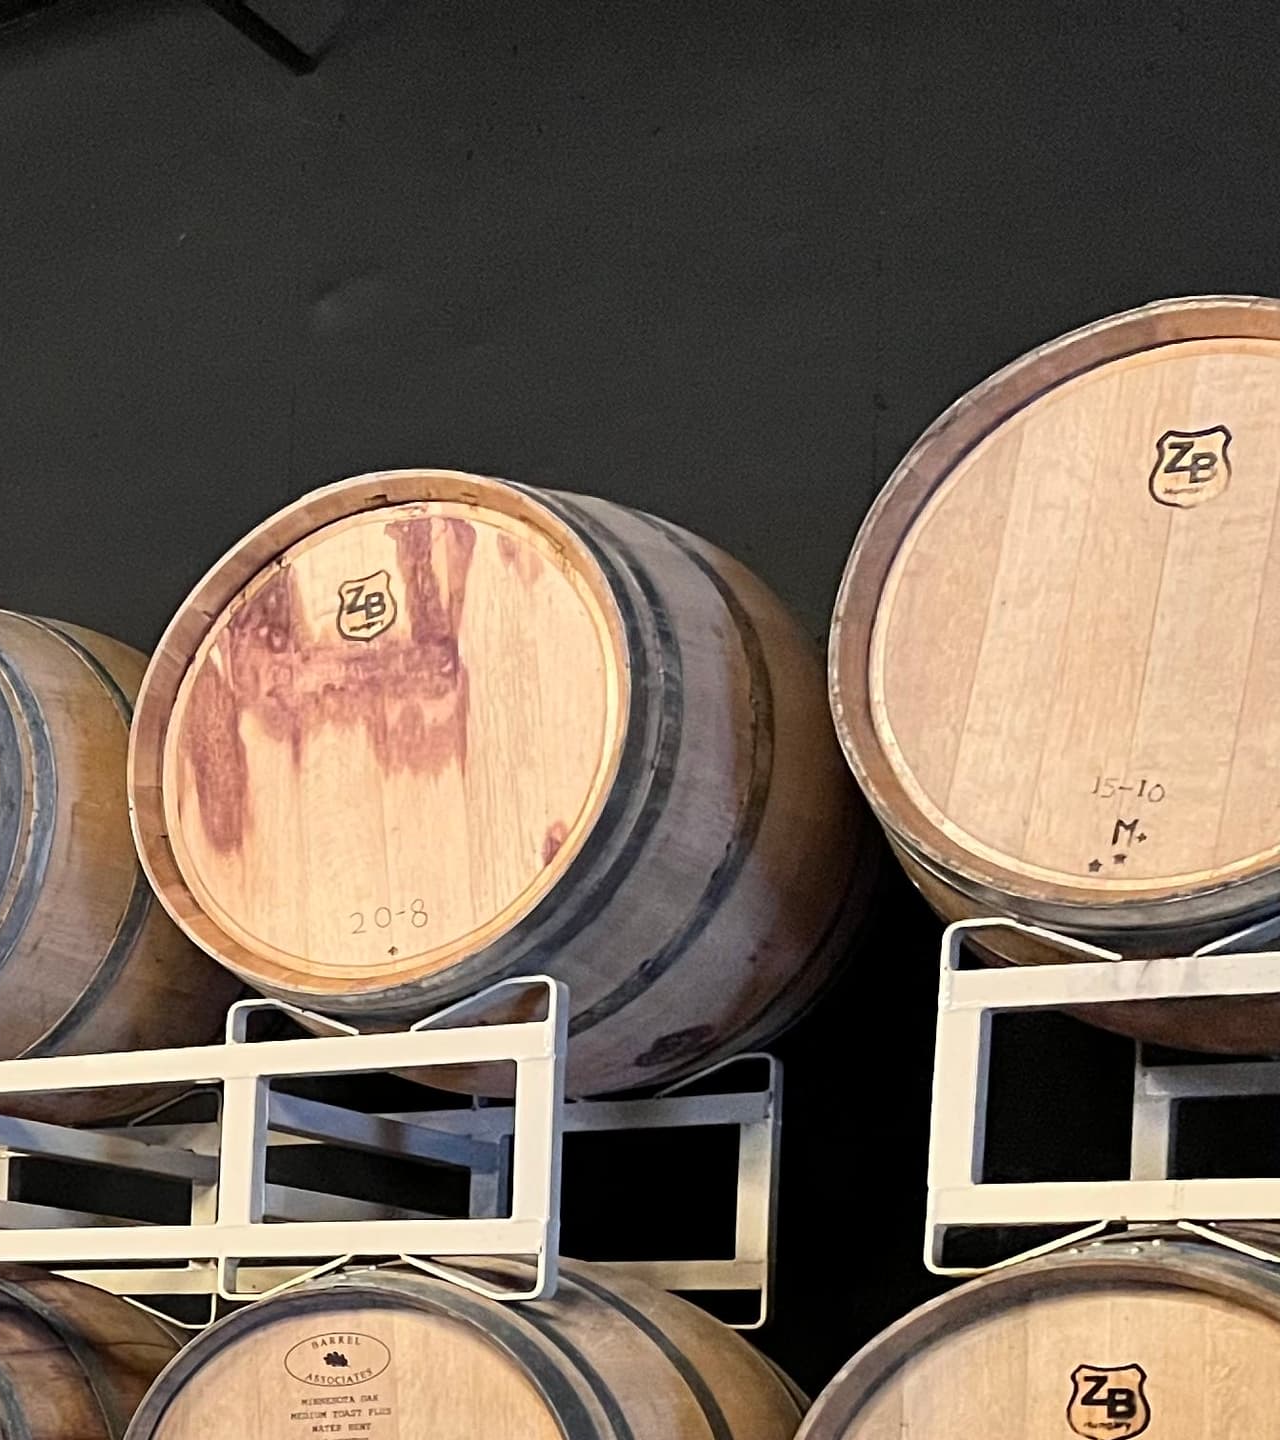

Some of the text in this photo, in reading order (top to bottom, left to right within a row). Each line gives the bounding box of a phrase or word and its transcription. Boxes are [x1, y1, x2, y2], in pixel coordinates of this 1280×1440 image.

[1164, 440, 1218, 484] ZB
[346, 584, 386, 621] ZB
[1091, 776, 1166, 803] 15-10
[350, 898, 428, 934] 20-8
[311, 1335, 361, 1350] BARREL
[305, 1367, 374, 1385] ASSOCIATES
[1081, 1375, 1138, 1420] ZB
[332, 1409, 362, 1419] TOAST
